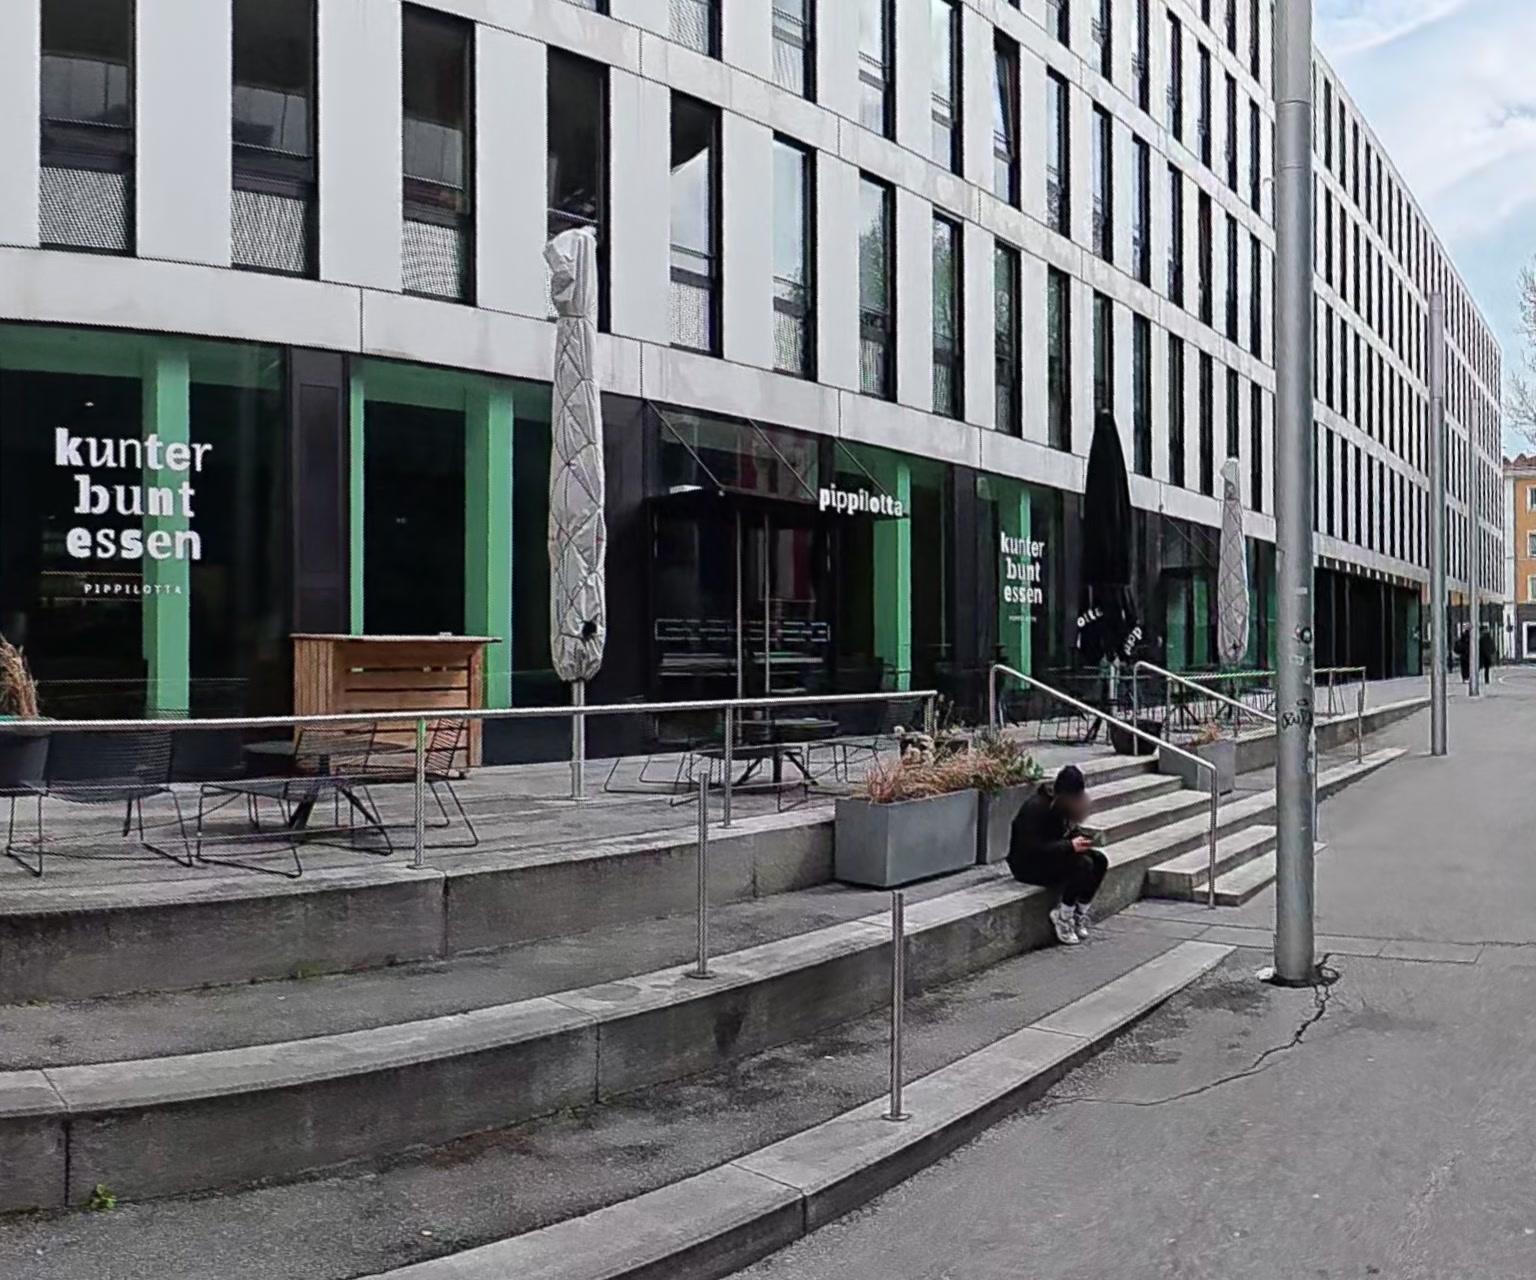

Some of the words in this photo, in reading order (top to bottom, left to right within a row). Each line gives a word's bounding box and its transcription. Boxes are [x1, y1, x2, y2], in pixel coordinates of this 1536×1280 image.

[55, 427, 213, 471] kunter
[73, 474, 195, 518] bunt
[819, 483, 903, 517] pippilotta
[66, 527, 202, 560] essen
[1000, 531, 1045, 558] kunter
[1006, 557, 1041, 582] bunt
[84, 584, 182, 594] PIPPILOTTA
[1003, 585, 1043, 604] essen
